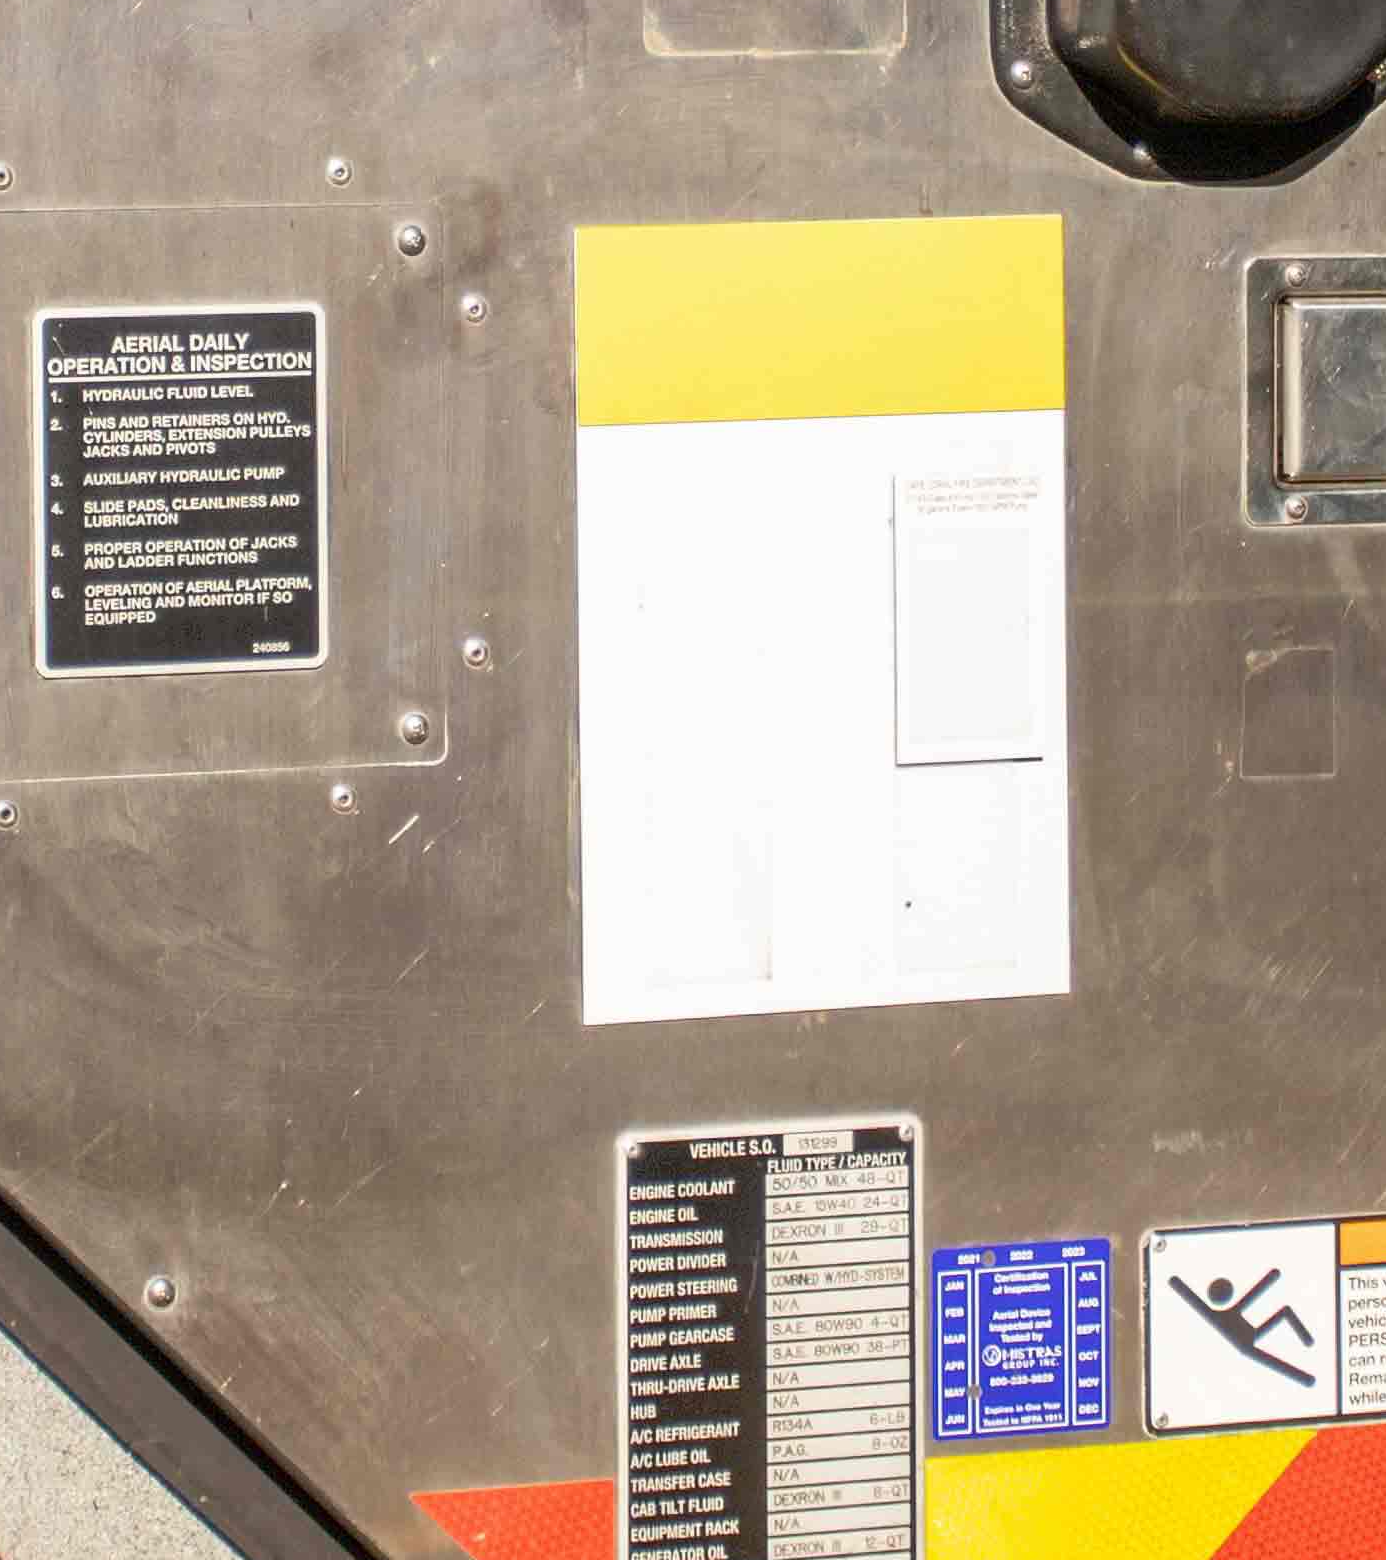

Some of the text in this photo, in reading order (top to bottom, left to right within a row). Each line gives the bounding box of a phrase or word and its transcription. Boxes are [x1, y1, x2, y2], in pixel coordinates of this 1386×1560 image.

[111, 334, 248, 352] AERIAL DAILY
[47, 353, 310, 375] OPERATION & INSPECTION
[50, 386, 253, 402] 1. HYDRAULIC FLUID LEVEL
[49, 412, 290, 431] 2. PINS AND RETAINERS ON HYD.
[83, 425, 311, 445] CYLINDERS, EXTENSION PULLEYS
[83, 442, 215, 457] JACKS AND PIVOTS
[50, 468, 284, 486] 3. AUXILIARY HYDRAULIC PUMP
[51, 495, 299, 514] 4. SLIDE PADS, CLEANLINESS AND
[84, 513, 178, 527] LUBRICATION
[52, 537, 297, 556] 5. PROPER OPERATION OF JACKS
[84, 552, 257, 569] AND LADDER FUNCTIONS
[51, 577, 312, 598] 6. OPERATION OF AERIAL PLATFORM,
[84, 592, 292, 610] LEVELING AND MONITOR IF SO
[84, 611, 155, 624] EQUIPPED
[690, 1138, 776, 1158] VEHICLE S.O.
[767, 1158, 802, 1173] FLUID
[806, 1156, 835, 1170] TYPE
[847, 1151, 905, 1168] CAPACITY
[629, 1179, 735, 1200] ENGINE COOLANT
[630, 1207, 698, 1224] ENGINE OIL
[630, 1229, 723, 1249] TRANSMISSION
[630, 1253, 725, 1272] POWER DIVIDER
[773, 1250, 797, 1263] N/A
[630, 1277, 737, 1298] POWER STEERING
[1349, 1276, 1378, 1289] This
[630, 1304, 716, 1323] PUMP PRIMER
[772, 1297, 798, 1311] N/A
[630, 1327, 733, 1348] PUMP GEARCASE
[630, 1353, 701, 1372] DRIVE AXLE
[1078, 1351, 1098, 1360] OCT
[1349, 1356, 1374, 1365] can
[631, 1374, 739, 1396] THRU-DRIVE AXLE
[773, 1373, 798, 1385] N/A
[1349, 1391, 1386, 1404] while
[630, 1404, 656, 1420] HUB
[630, 1422, 739, 1444] A/C REFRIGERANT
[631, 1448, 710, 1469] A/C LUBE OIL
[631, 1471, 730, 1493] TRANSFER CASE
[631, 1496, 724, 1517] CAB TILT FLUID
[631, 1520, 739, 1542] EQUIPMENT RACK
[708, 1545, 727, 1560] OIL
